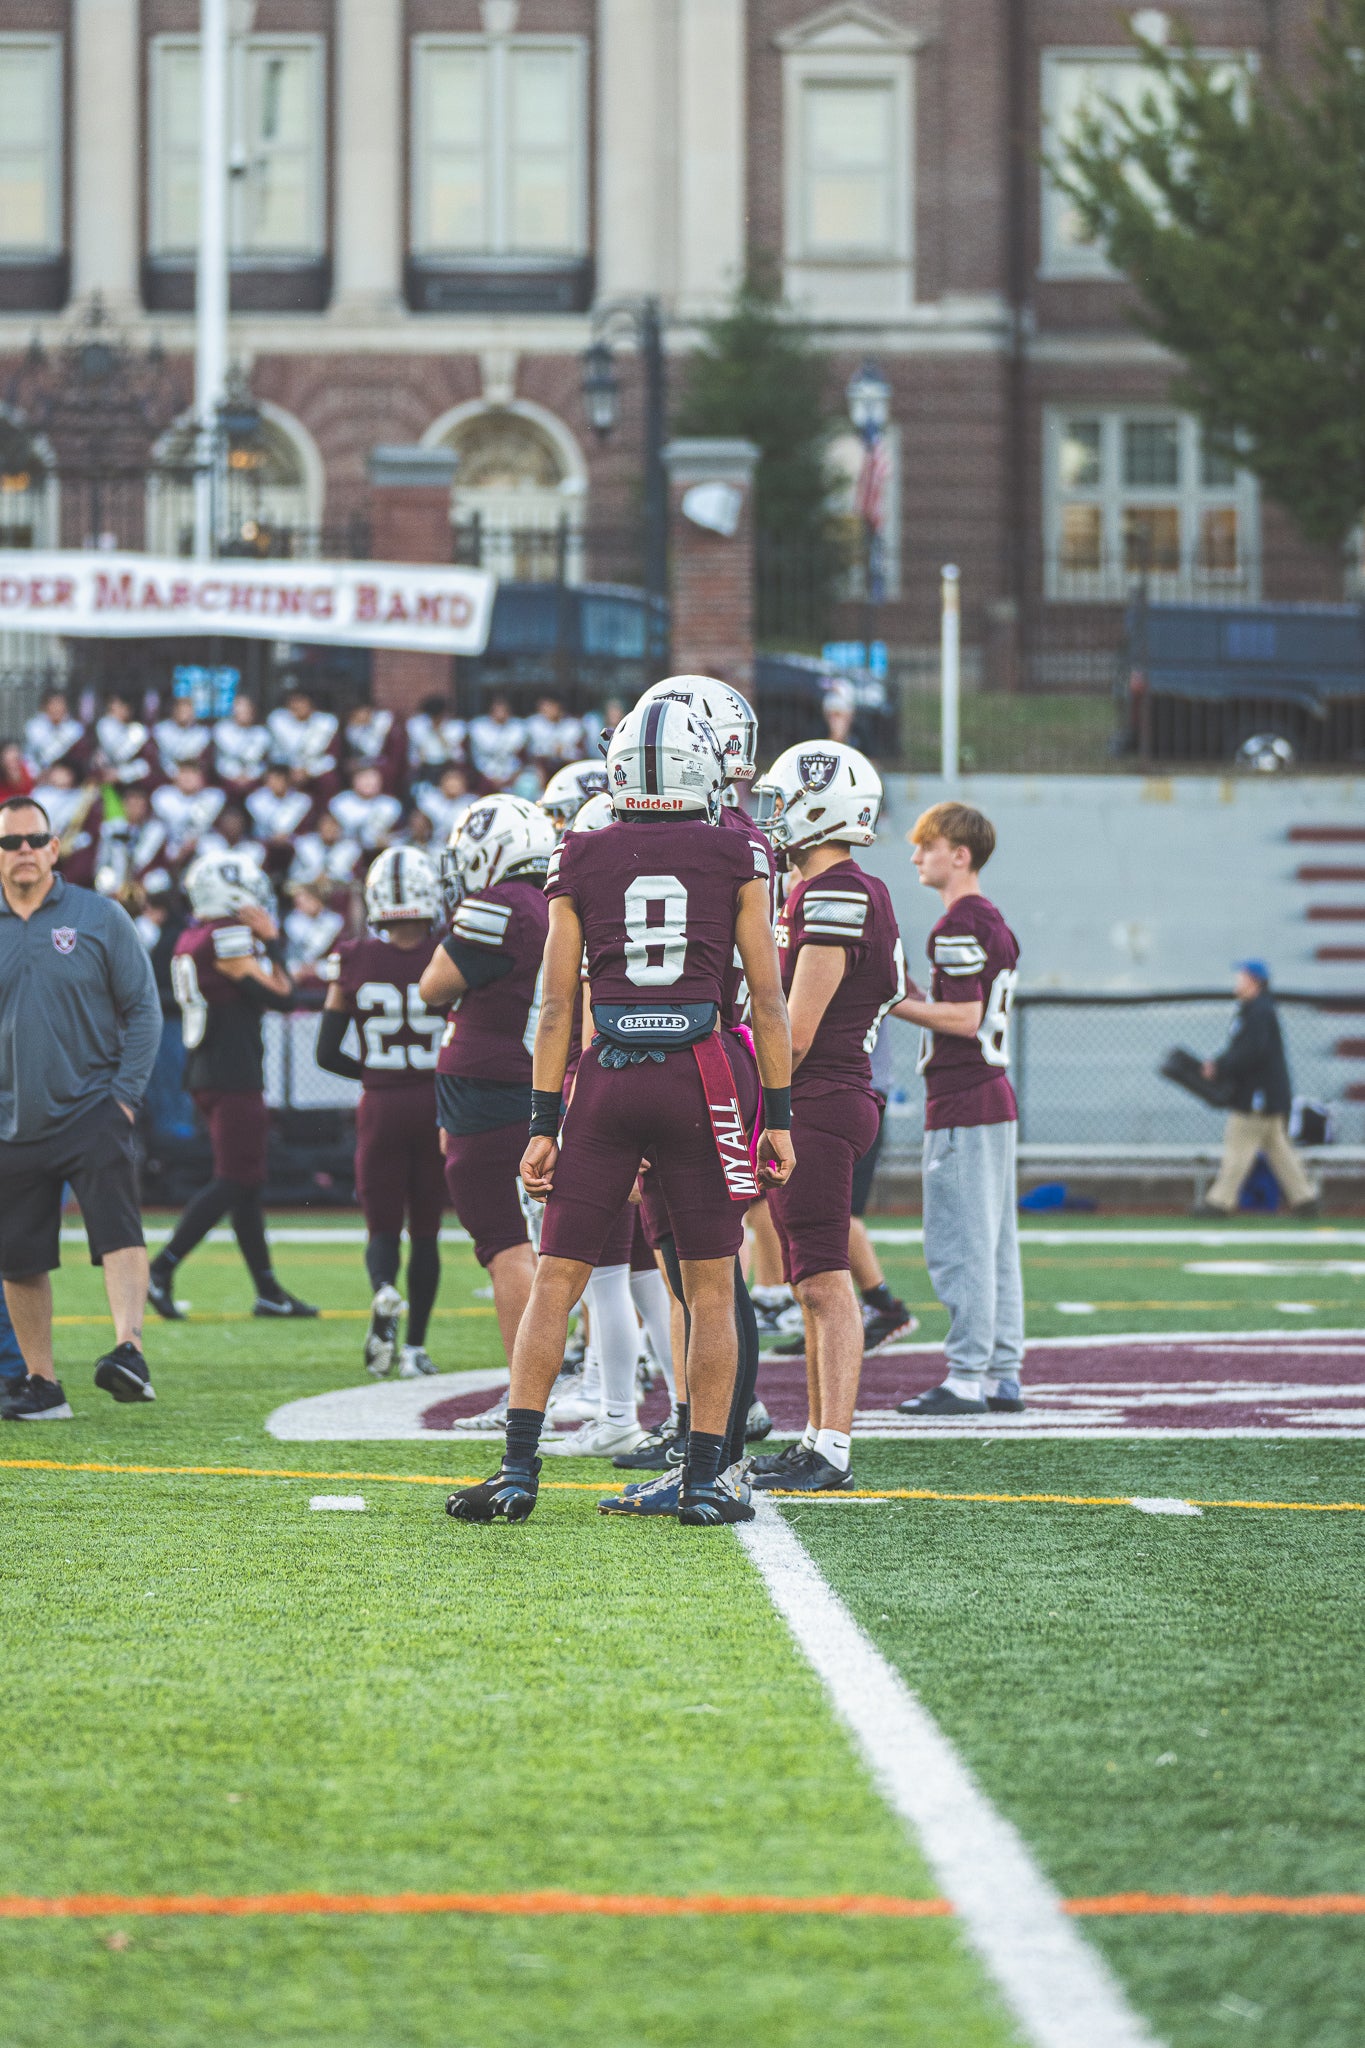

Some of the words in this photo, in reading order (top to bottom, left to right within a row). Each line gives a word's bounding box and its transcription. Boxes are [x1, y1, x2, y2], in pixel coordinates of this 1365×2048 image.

[94, 570, 335, 620] MARCHING
[355, 583, 474, 628] BAND
[625, 797, 683, 810] Riddell
[624, 875, 688, 986] 8
[356, 982, 447, 1069] 25
[623, 1017, 684, 1029] BATTLE
[709, 1098, 759, 1194] MYALL
